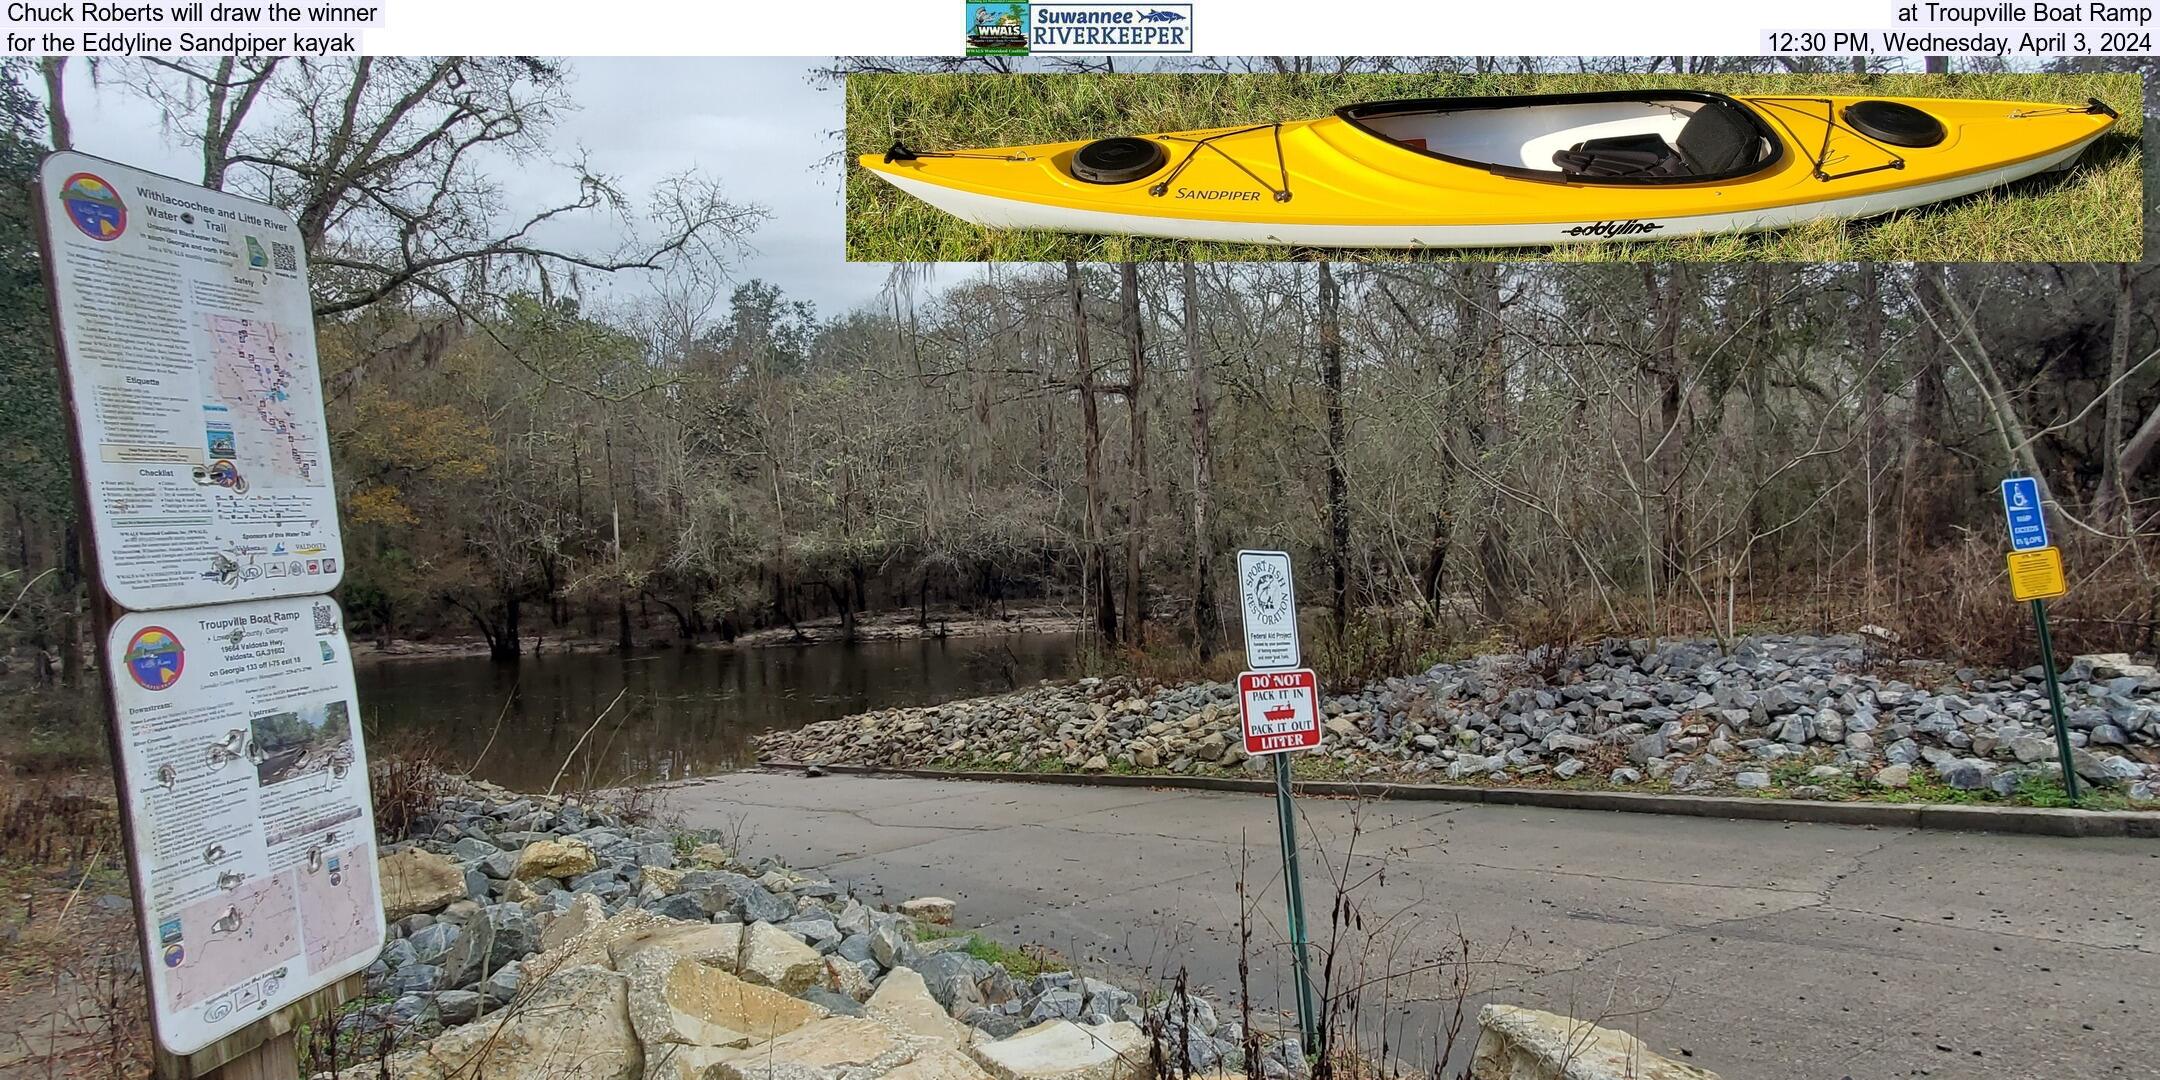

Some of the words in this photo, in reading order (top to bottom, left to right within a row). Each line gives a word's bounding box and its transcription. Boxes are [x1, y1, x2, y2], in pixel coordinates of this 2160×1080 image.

[1176, 188, 1261, 201] SANDPIPER
[137, 187, 214, 214] Withlacoochee
[218, 209, 236, 220] and
[238, 212, 262, 226] Little
[264, 218, 288, 232] River
[146, 205, 178, 222] Water
[204, 220, 227, 233] Trail
[1562, 220, 1663, 238] eddyline
[166, 238, 190, 249] Georgia
[220, 249, 238, 258] Florida
[234, 276, 254, 287] Safety
[126, 376, 160, 386] Etiquette
[140, 469, 174, 477] Checklist
[1246, 560, 1266, 587] SPORT
[1268, 564, 1286, 588] FISH
[1246, 592, 1288, 625] RESTORATION
[199, 616, 248, 630] Troupville
[250, 614, 272, 624] Boat
[274, 612, 300, 623] Ramp
[265, 626, 288, 635] Georgia
[1276, 632, 1292, 640] Project
[240, 641, 268, 651] Valdosta
[220, 665, 245, 675] Georgia
[259, 661, 268, 669] off
[268, 660, 281, 668] I-75
[282, 658, 292, 666] exit
[1252, 676, 1270, 688] DO
[1274, 674, 1302, 687] NOT
[1252, 690, 1274, 702] PACK
[1279, 690, 1288, 700] IT
[1293, 688, 1304, 698] IN
[129, 702, 172, 715] Downstream:
[1252, 724, 1274, 735] PACK
[1278, 722, 1286, 732] IT
[1291, 720, 1312, 731] OUT
[1261, 734, 1304, 750] LITTER
